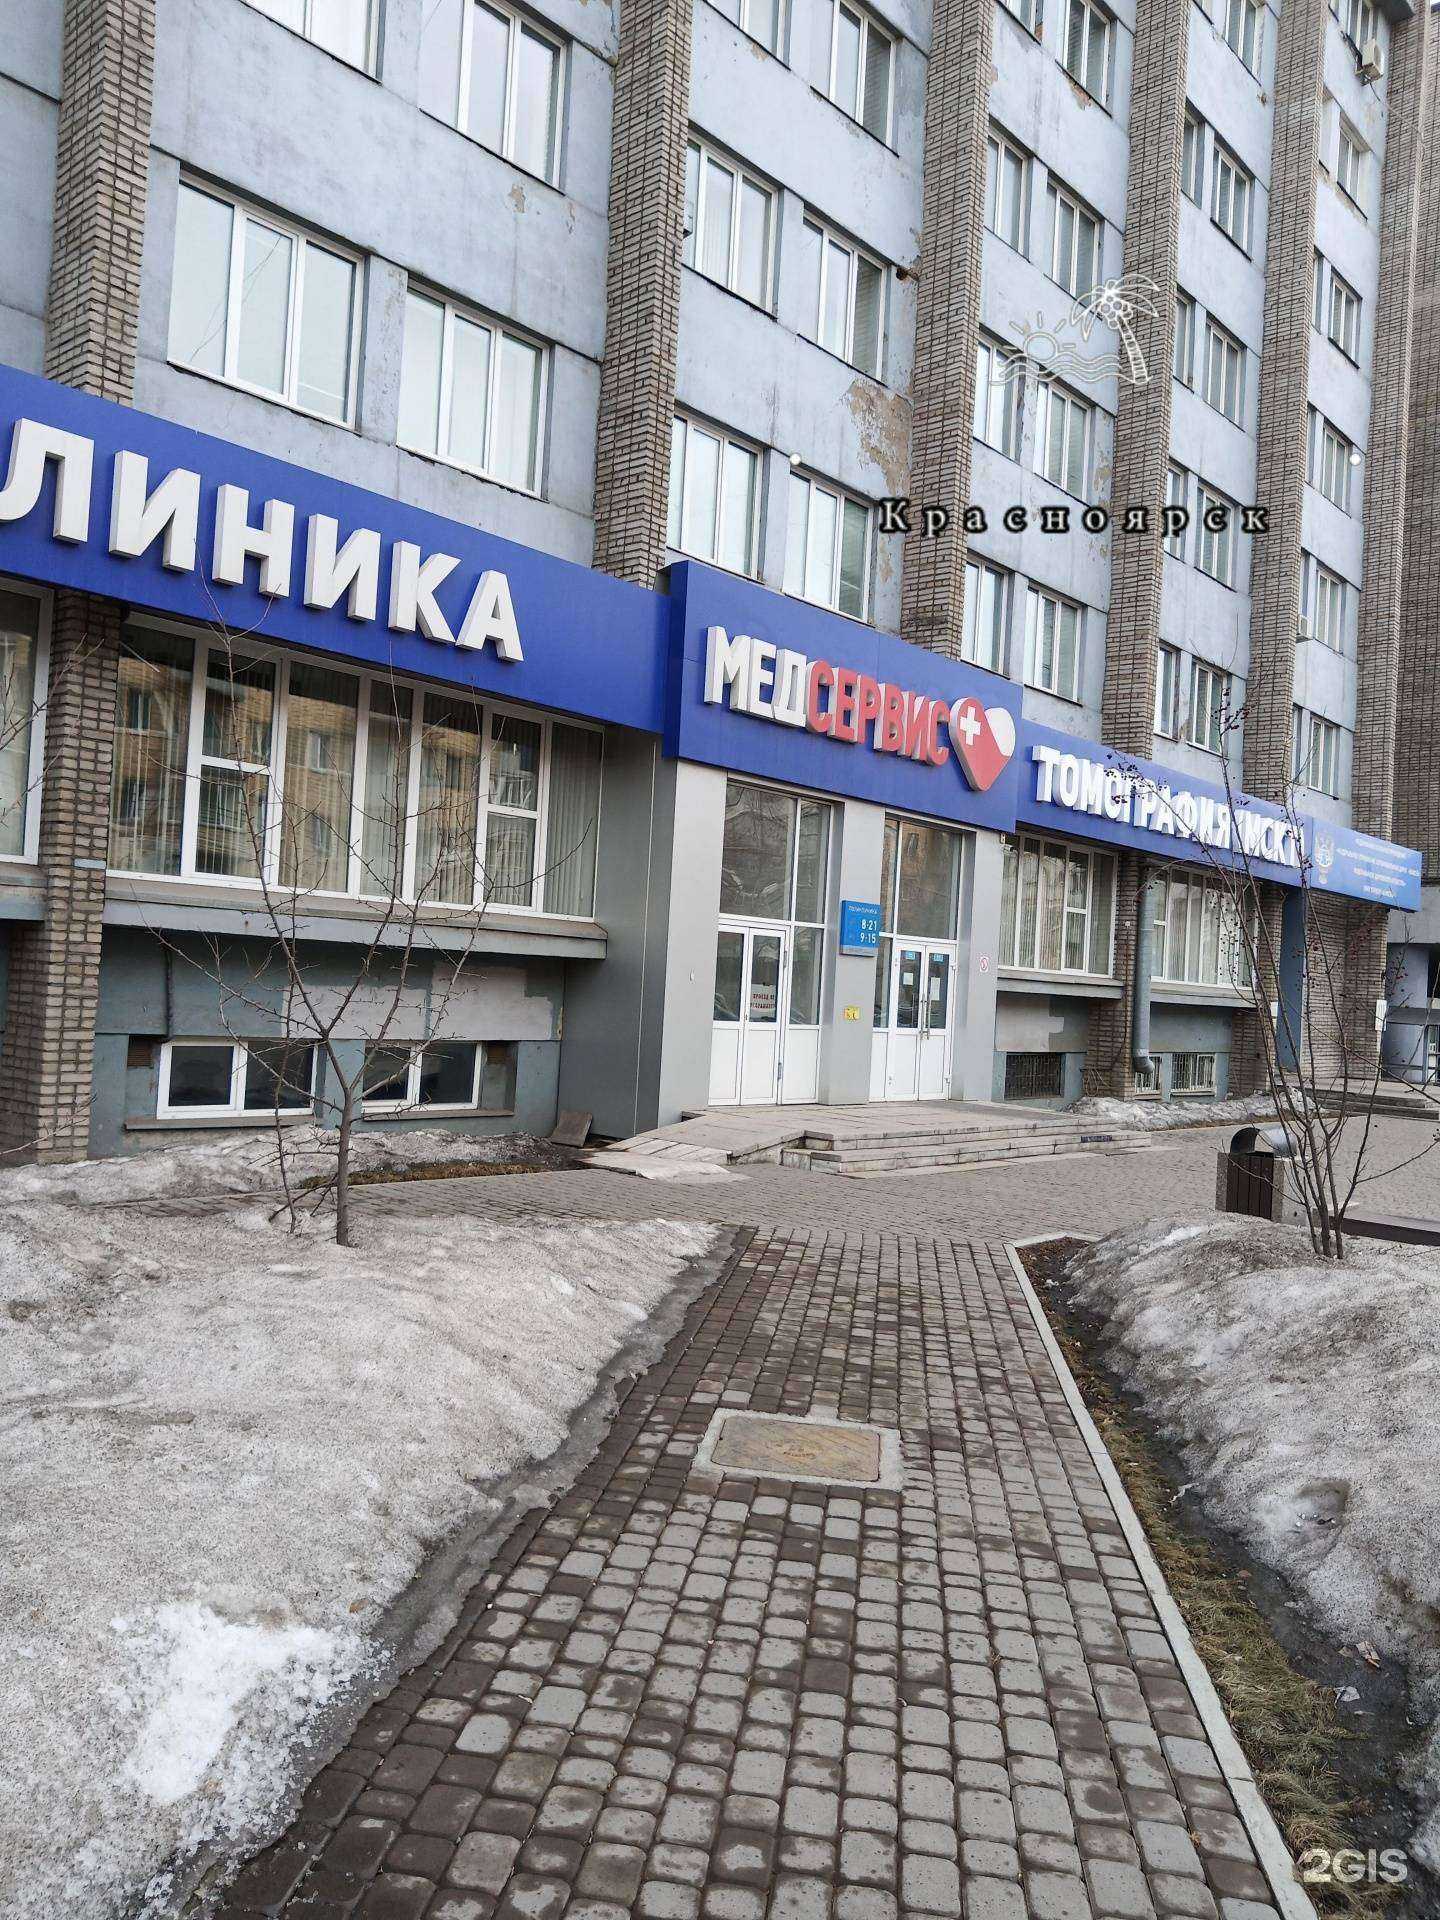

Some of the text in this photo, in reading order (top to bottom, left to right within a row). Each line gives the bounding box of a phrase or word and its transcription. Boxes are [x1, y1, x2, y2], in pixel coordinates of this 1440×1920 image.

[0, 418, 524, 662] ЛИНИКА
[704, 626, 950, 766] МЕДСЕРВИС
[1032, 745, 1231, 849] ТОМОГРАФИЯ
